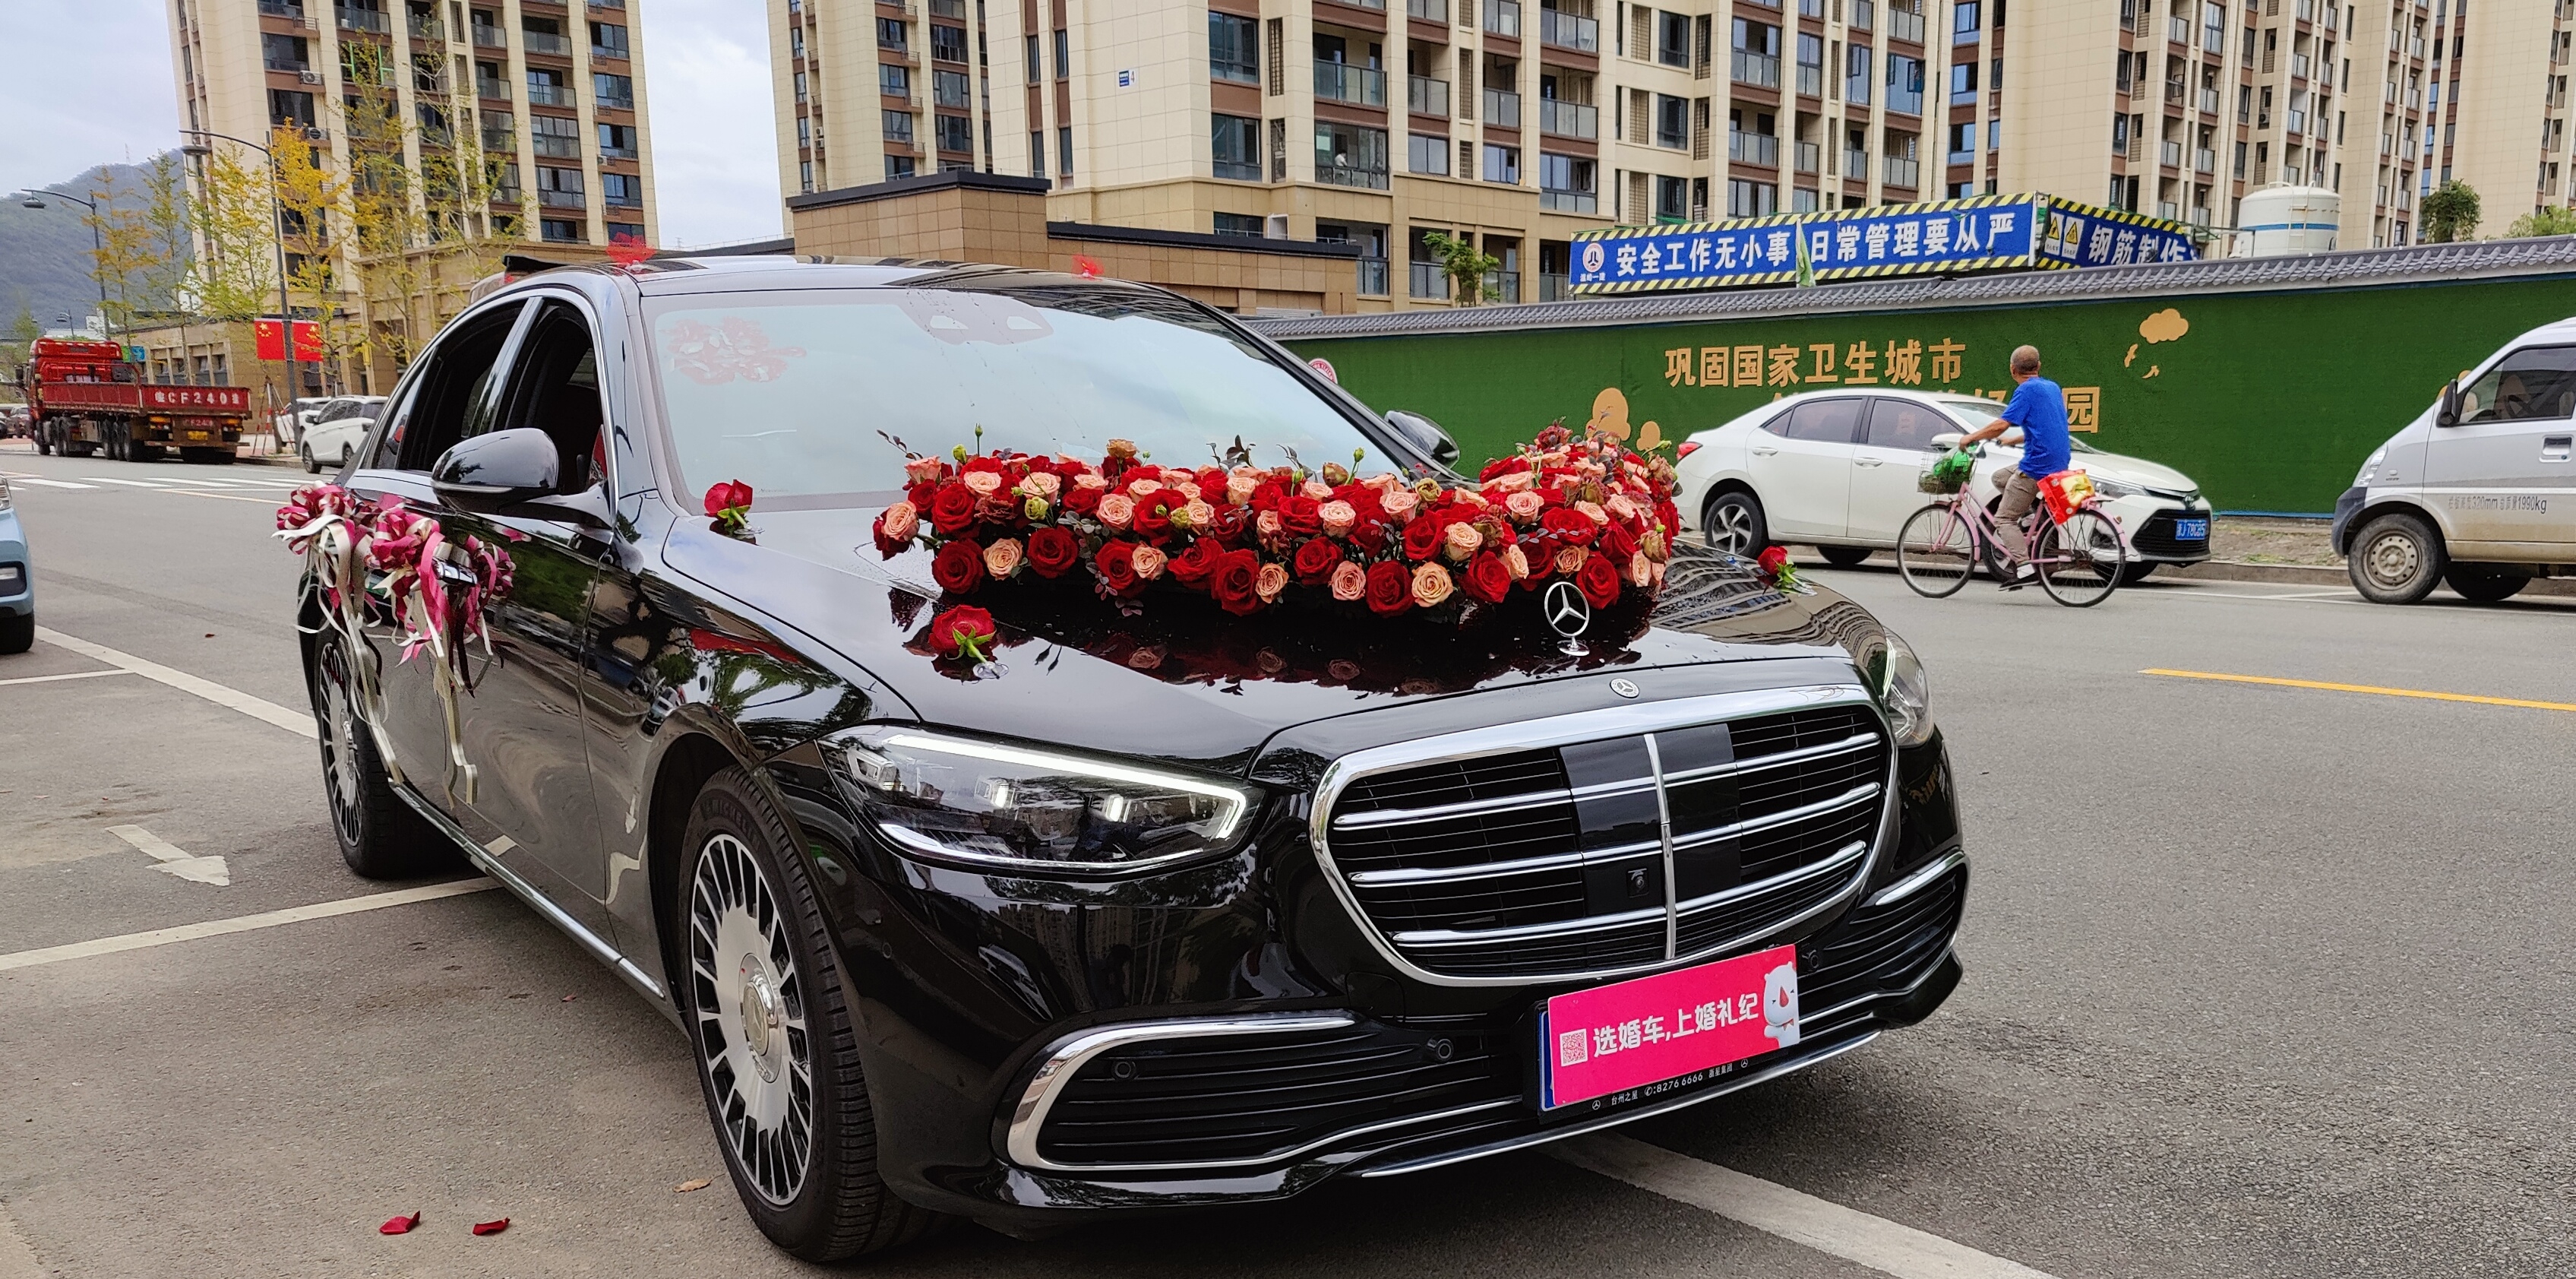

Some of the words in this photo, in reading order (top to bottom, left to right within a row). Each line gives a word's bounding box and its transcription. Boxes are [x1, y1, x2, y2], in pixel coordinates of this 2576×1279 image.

[1616, 231, 1791, 277] 安全工作无小事
[1811, 213, 2015, 263] 日常管理要从严
[2088, 224, 2198, 265] 钢筋制作
[1664, 337, 1966, 388] 巩固国家卫生城市
[2062, 386, 2100, 434] 园
[1593, 992, 1759, 1057] 选婚车,上婚礼纪
[1611, 1090, 1638, 1106] 台州之星
[1681, 1072, 1703, 1086] 6666
